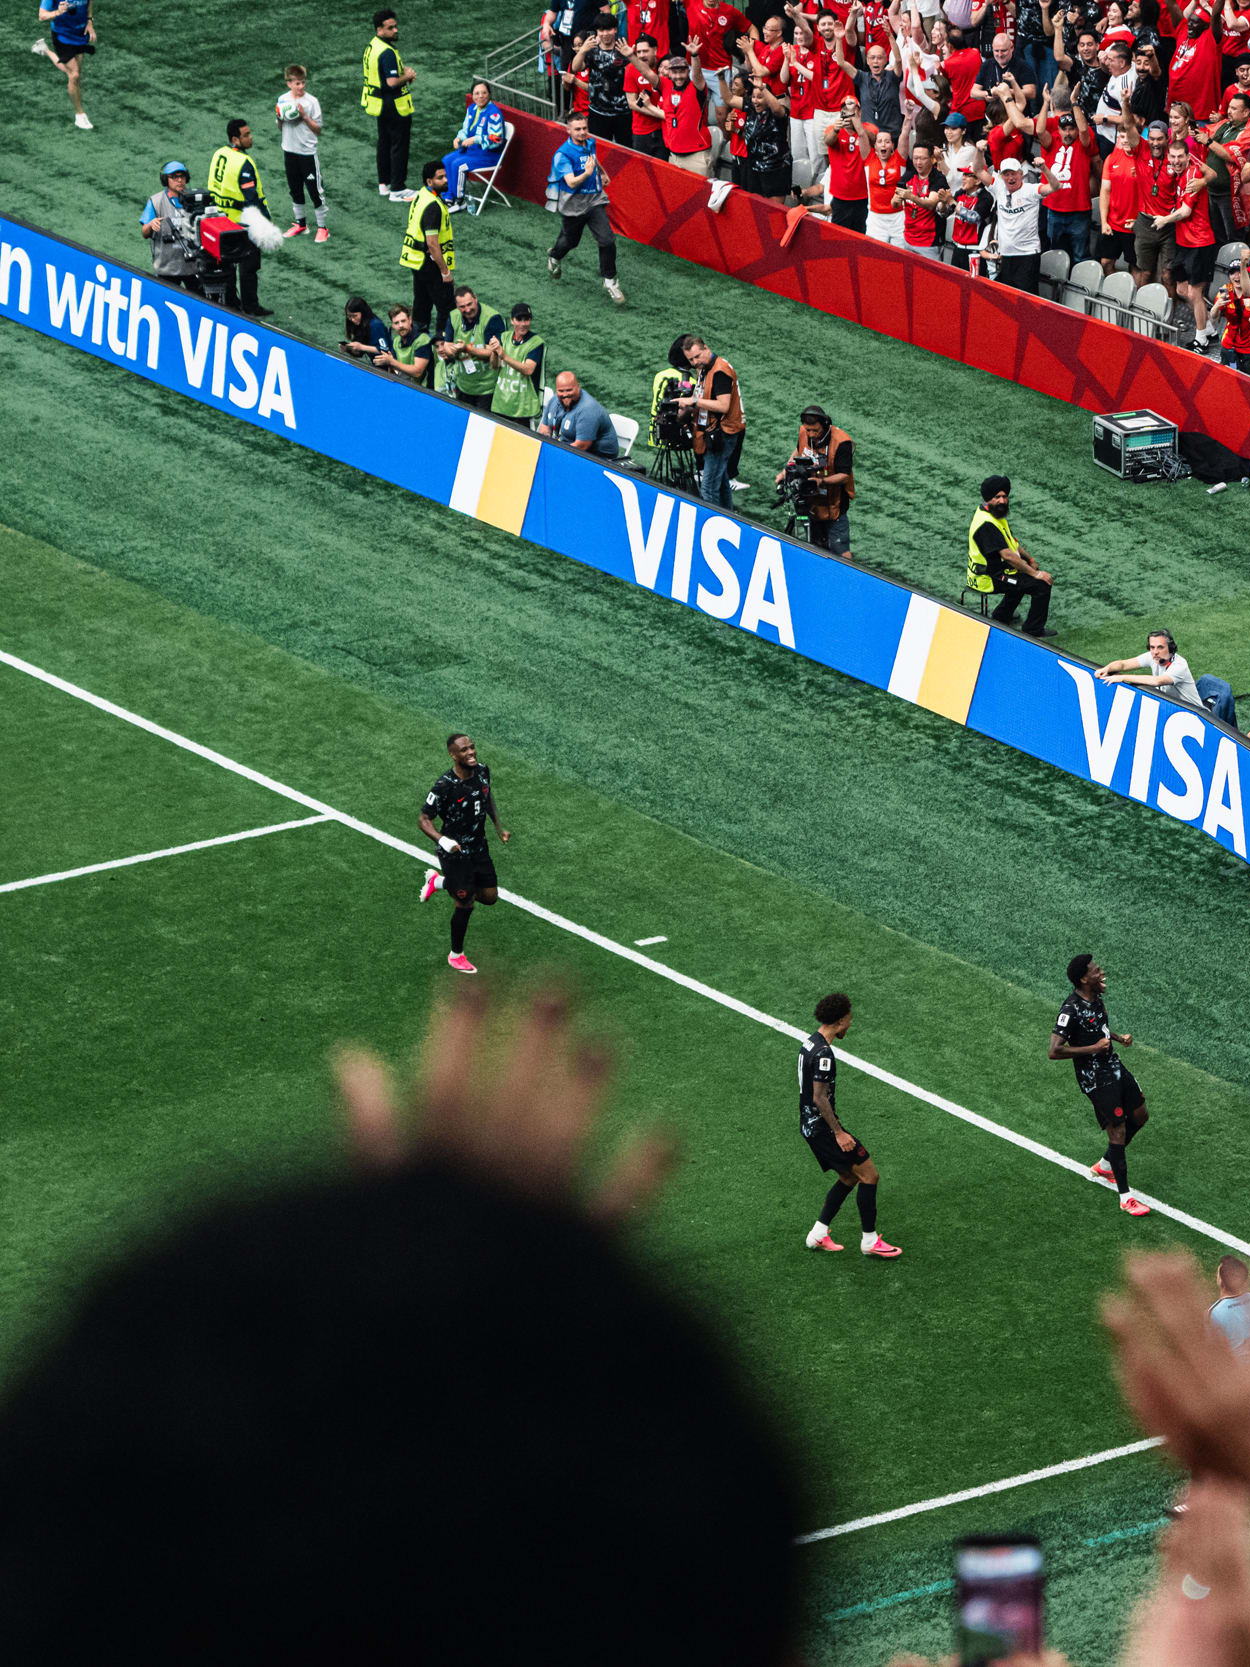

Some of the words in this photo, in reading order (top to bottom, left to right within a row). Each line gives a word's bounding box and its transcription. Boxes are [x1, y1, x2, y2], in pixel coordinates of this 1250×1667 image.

[45, 254, 161, 371] with
[164, 300, 297, 430] VISA
[603, 470, 796, 649] VISA
[1058, 659, 1247, 859] VISA
